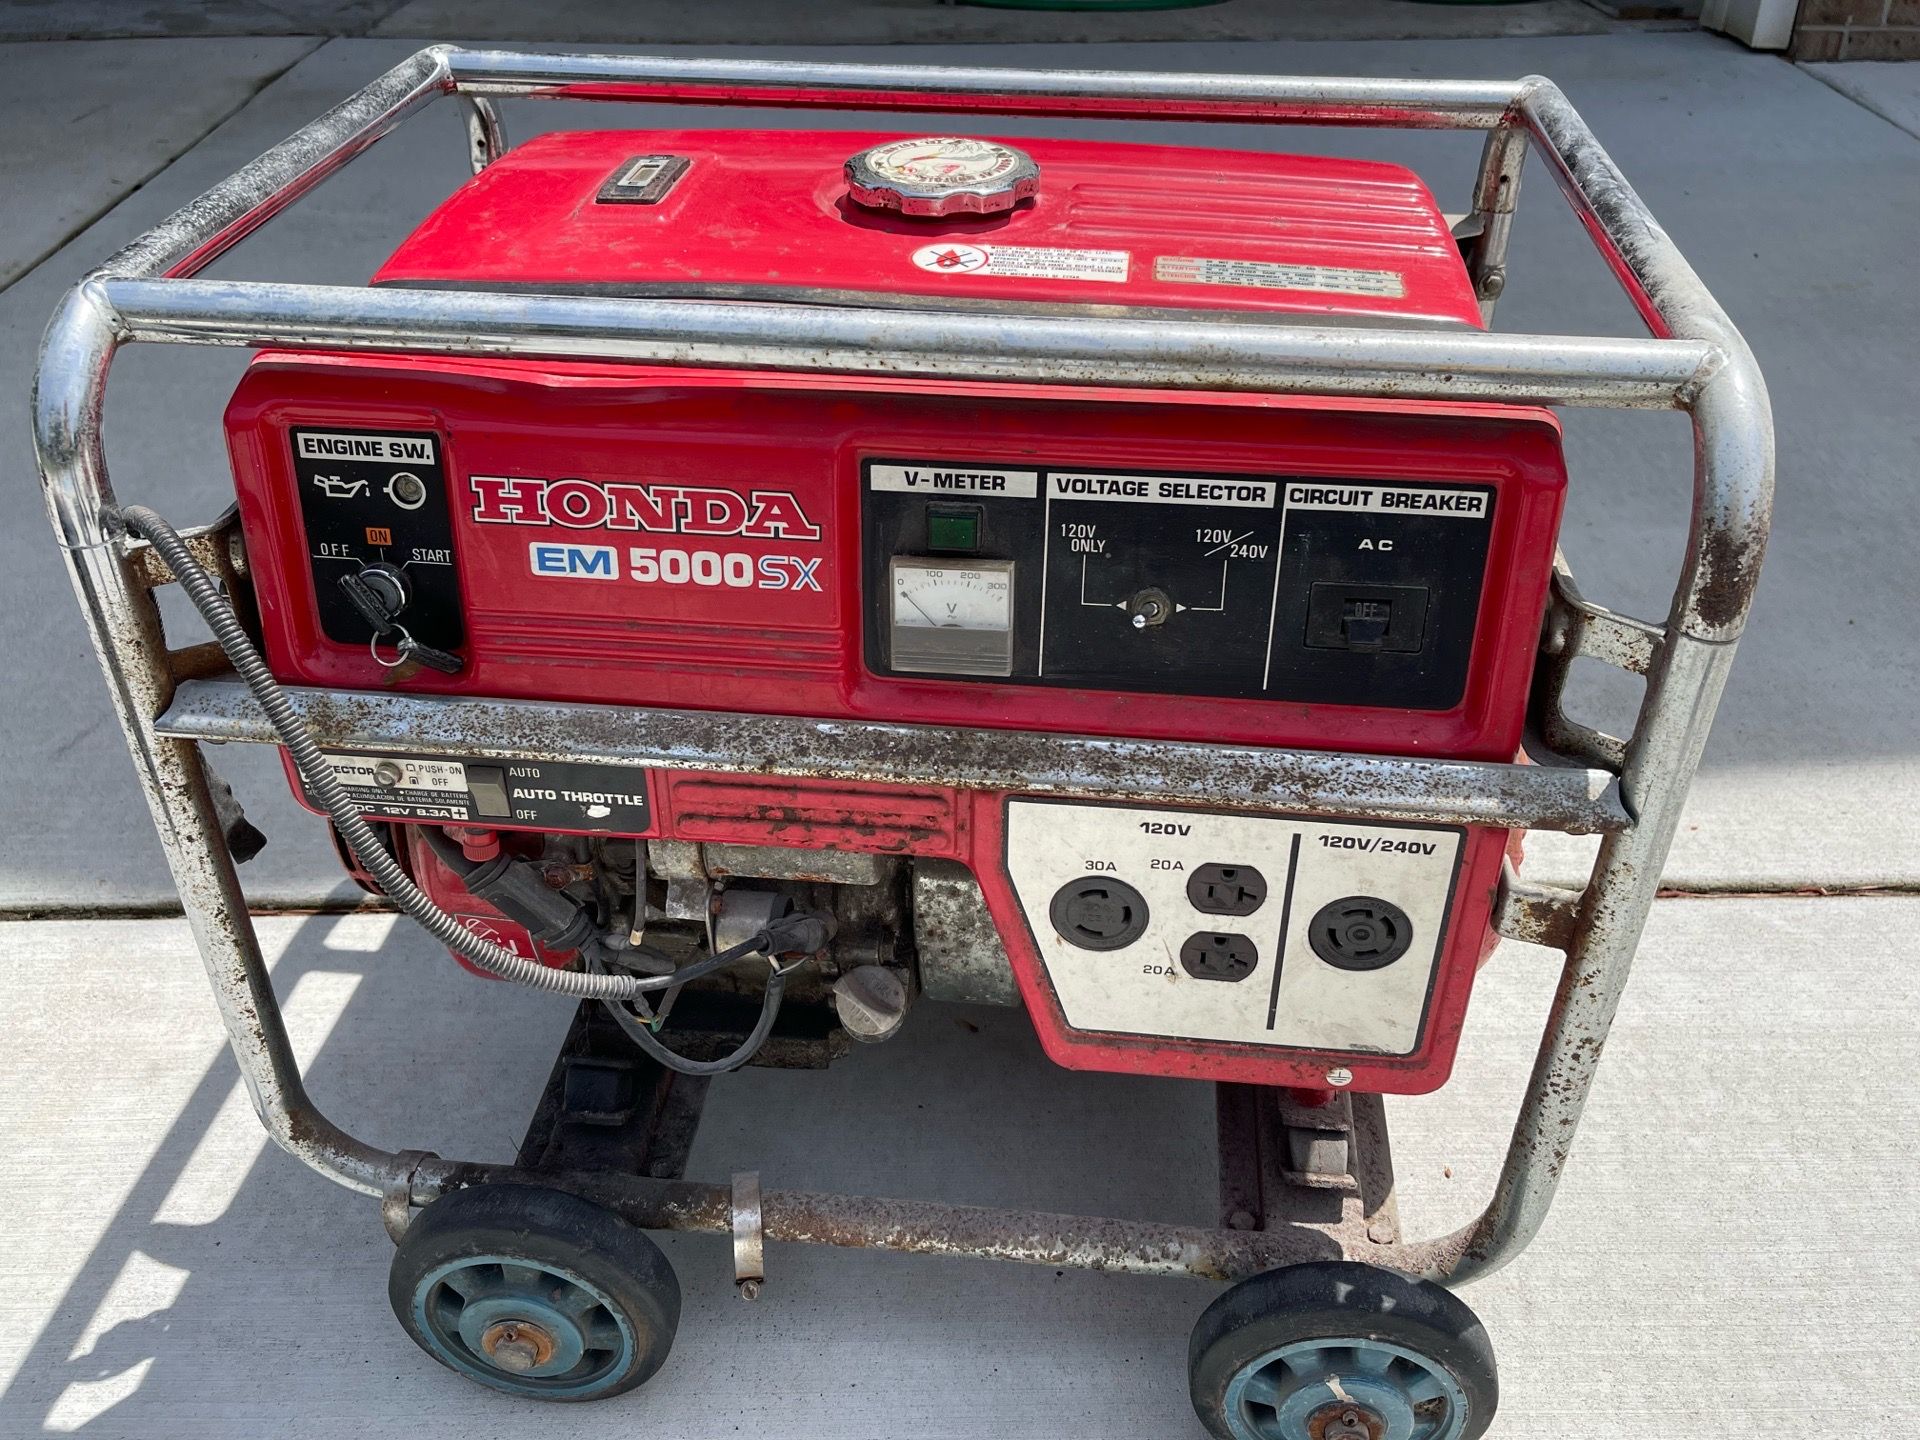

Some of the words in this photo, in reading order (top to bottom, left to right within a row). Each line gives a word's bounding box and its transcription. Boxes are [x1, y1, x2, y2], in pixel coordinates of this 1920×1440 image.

[303, 438, 383, 457] ENGINE
[389, 443, 430, 460] SW.
[904, 471, 1006, 490] V-METER
[1056, 478, 1149, 497] VOLTAGE
[1159, 482, 1266, 502] SELECTOR
[1289, 488, 1373, 506] CIRCUIT
[1381, 492, 1483, 512] BREAKER
[469, 474, 822, 541] HONDA
[370, 530, 388, 543] ON
[1061, 524, 1096, 538] 120V
[320, 543, 350, 557] OFF
[1071, 539, 1106, 553] ONLY
[412, 548, 450, 562] START
[536, 547, 611, 574] EM
[926, 570, 943, 578] 100
[946, 603, 957, 614] V
[1355, 602, 1378, 618] OFF
[330, 765, 375, 775] ECTOR
[509, 767, 540, 778] AUTO
[432, 778, 448, 786] OFF
[513, 788, 556, 800] AUTO
[561, 790, 643, 806] THROTTLE
[354, 804, 375, 812] DC
[383, 806, 410, 815] 12V
[416, 808, 450, 818] 8.3A
[516, 809, 538, 820] OFF
[1139, 821, 1191, 837] 120V
[1318, 834, 1436, 856] 120V/240V
[1085, 860, 1117, 872] 30A
[1150, 858, 1184, 871] 20A
[1143, 964, 1176, 976] 20A
